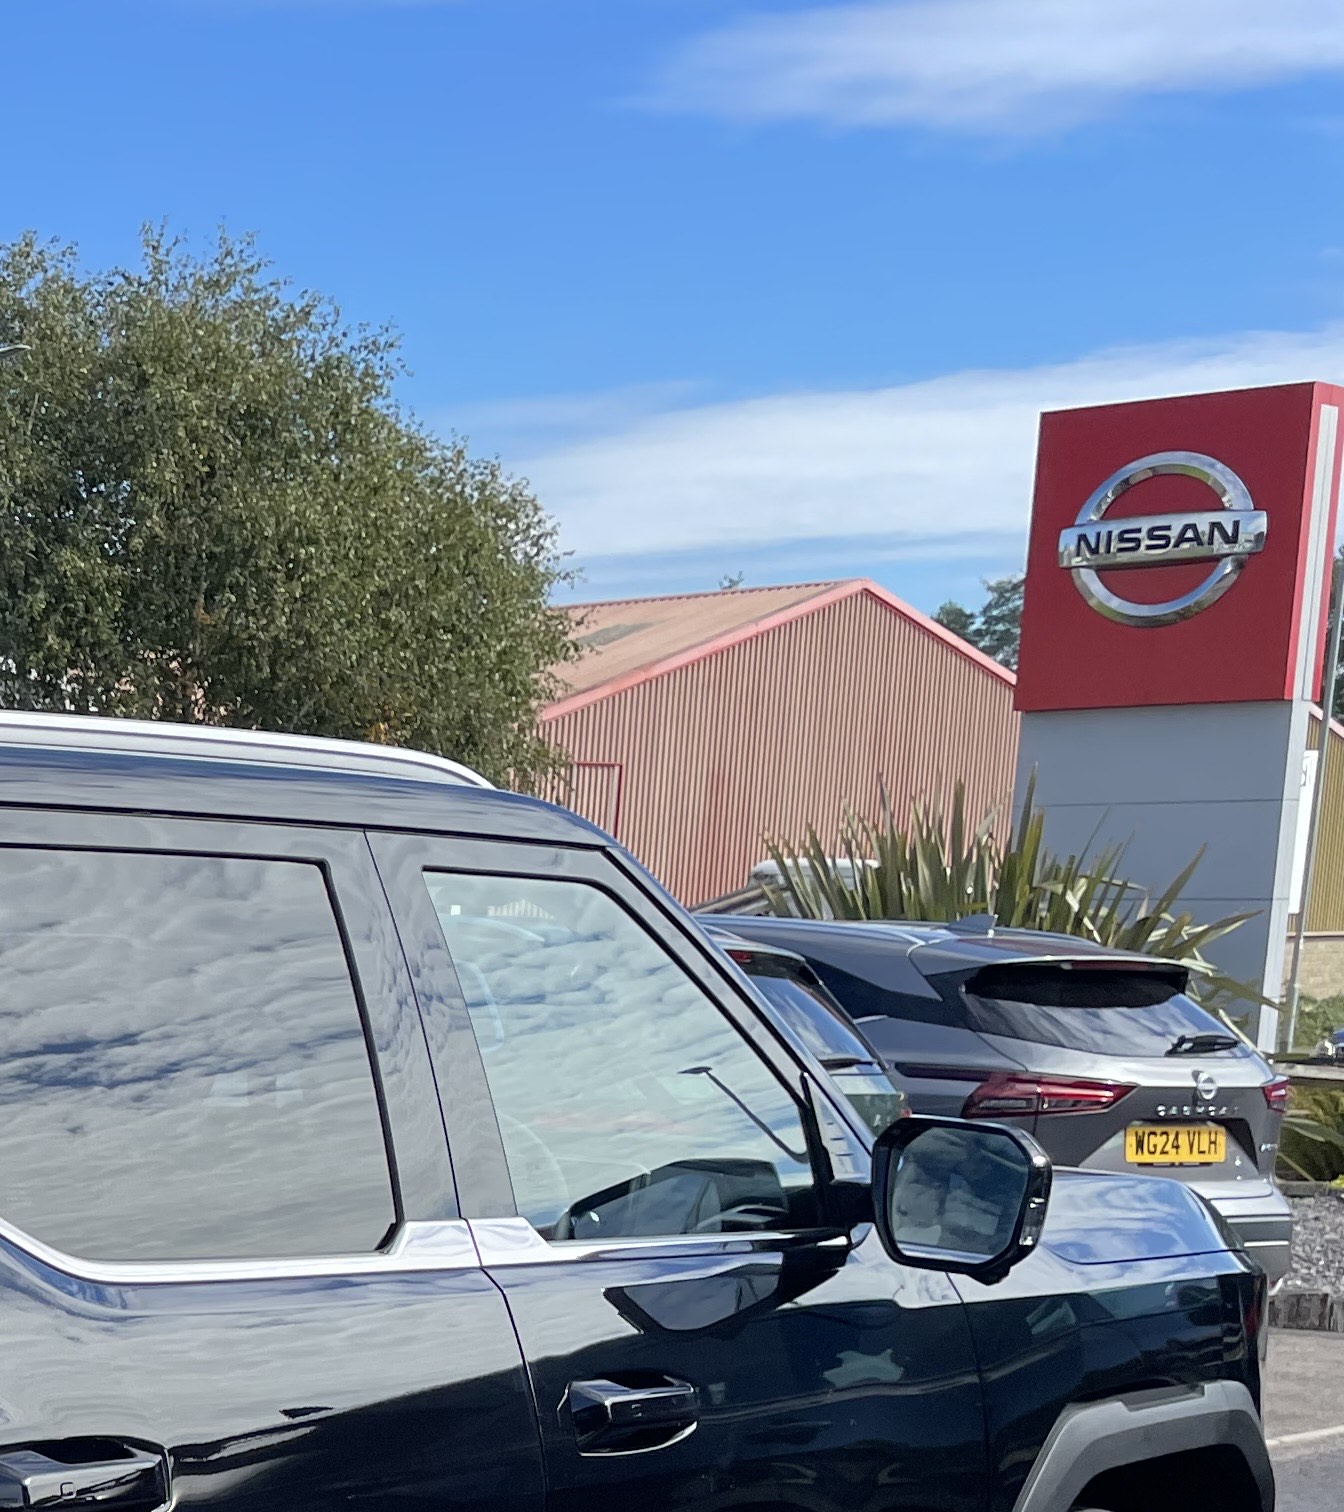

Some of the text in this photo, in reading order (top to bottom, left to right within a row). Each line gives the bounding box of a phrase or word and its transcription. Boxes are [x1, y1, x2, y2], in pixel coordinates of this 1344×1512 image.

[1075, 519, 1240, 557] NISSAN
[1134, 1129, 1218, 1155] WG24 VLH
